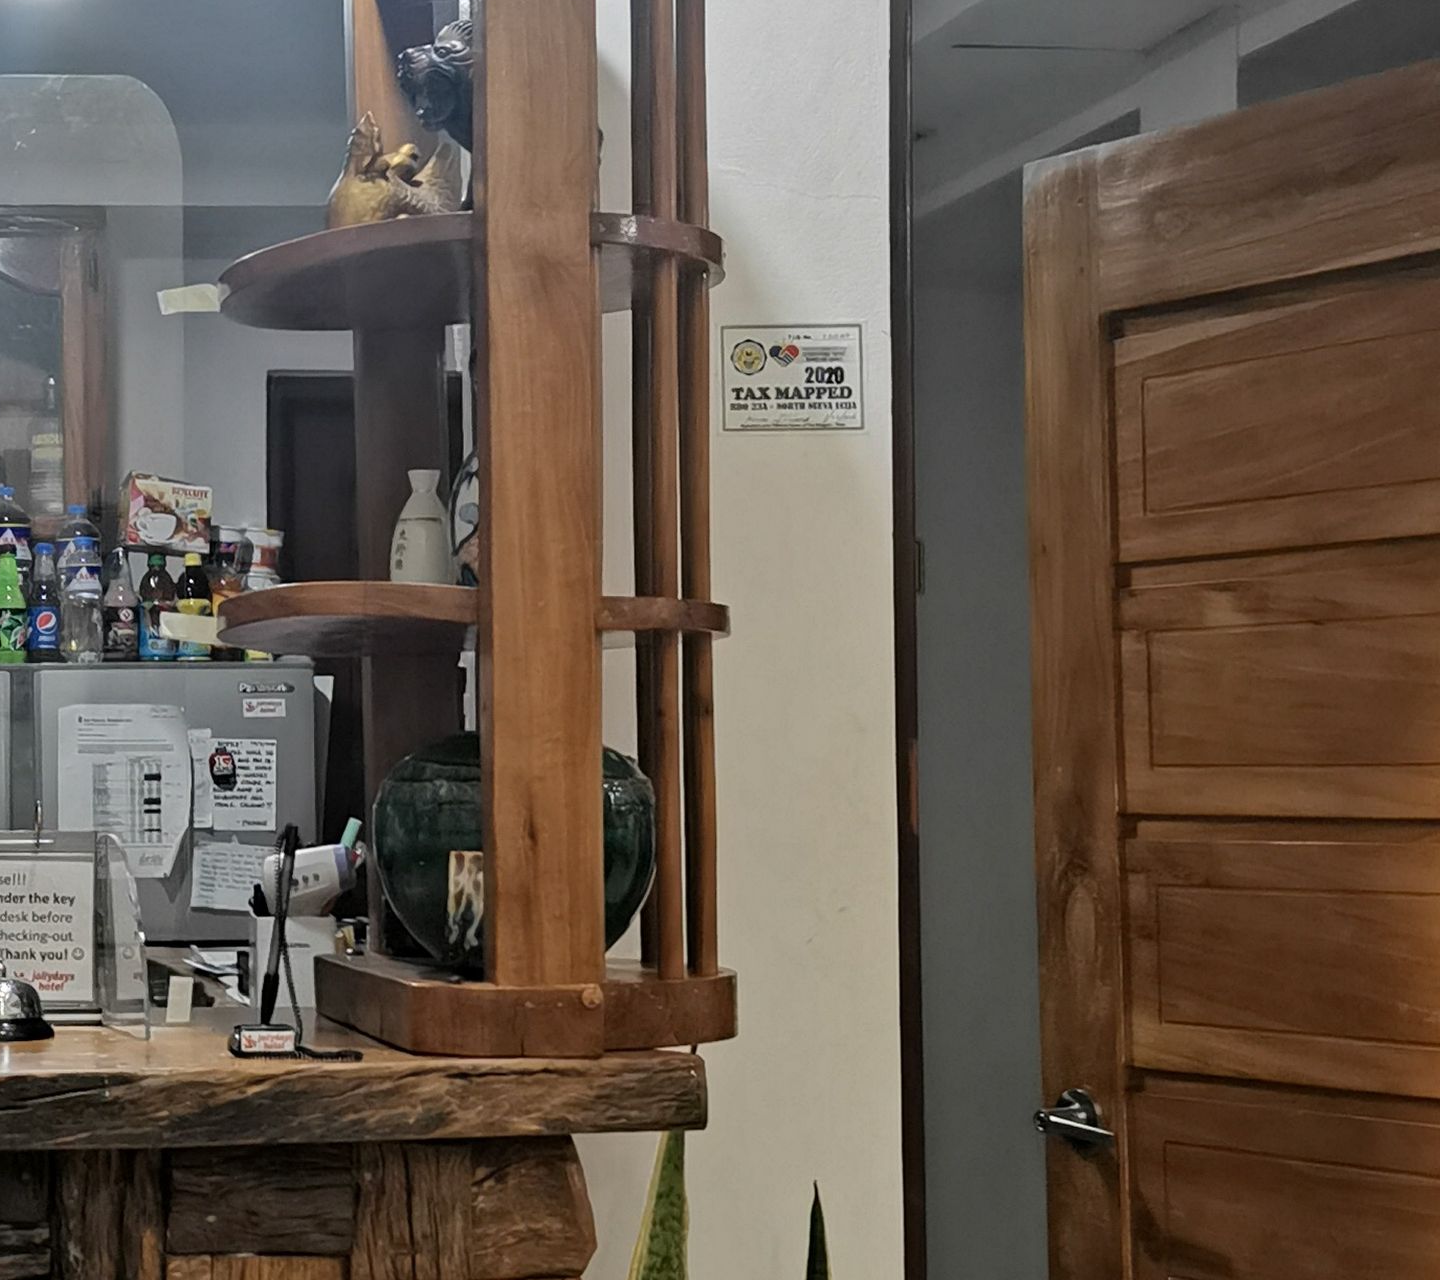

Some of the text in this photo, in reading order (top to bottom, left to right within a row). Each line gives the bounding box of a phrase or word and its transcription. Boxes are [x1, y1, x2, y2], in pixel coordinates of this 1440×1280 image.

[805, 366, 845, 385] 2020
[731, 386, 853, 400] TAX MAPPED
[777, 402, 805, 410] NORTH
[29, 892, 50, 904] the
[53, 892, 76, 907] key
[0, 910, 29, 922] desk
[32, 910, 73, 923] before
[39, 948, 68, 962] you!
